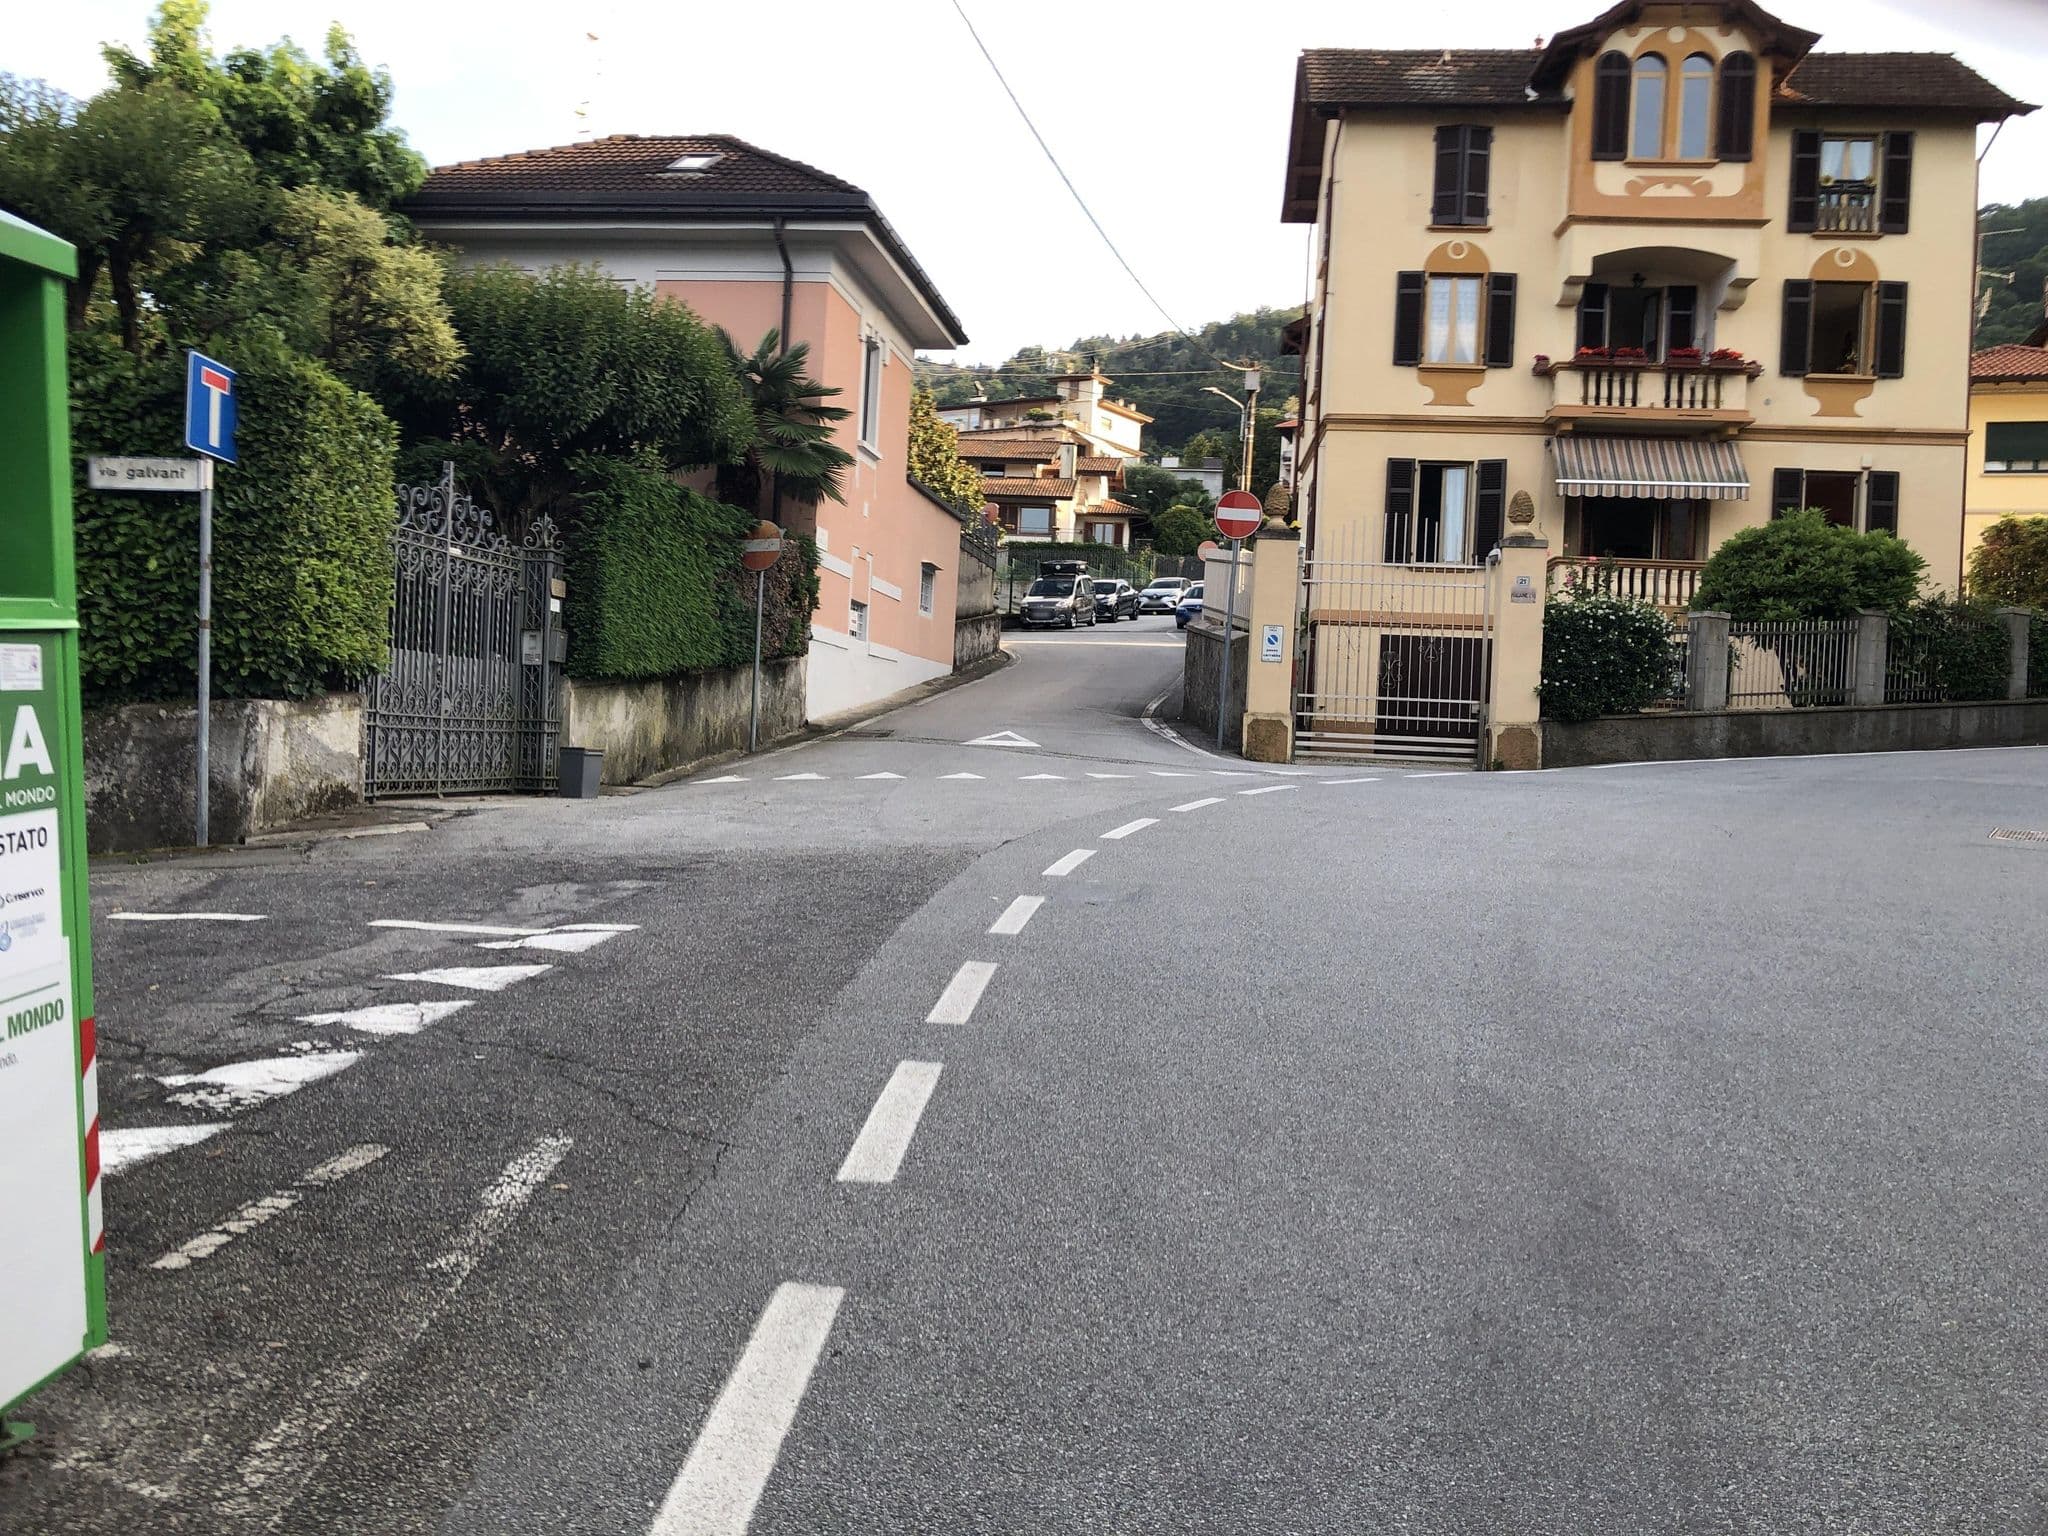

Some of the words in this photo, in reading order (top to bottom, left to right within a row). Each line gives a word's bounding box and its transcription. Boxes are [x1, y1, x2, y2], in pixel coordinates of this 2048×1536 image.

[126, 466, 186, 480] galvani
[5, 785, 56, 808] MONDO
[7, 998, 64, 1039] MONDO
